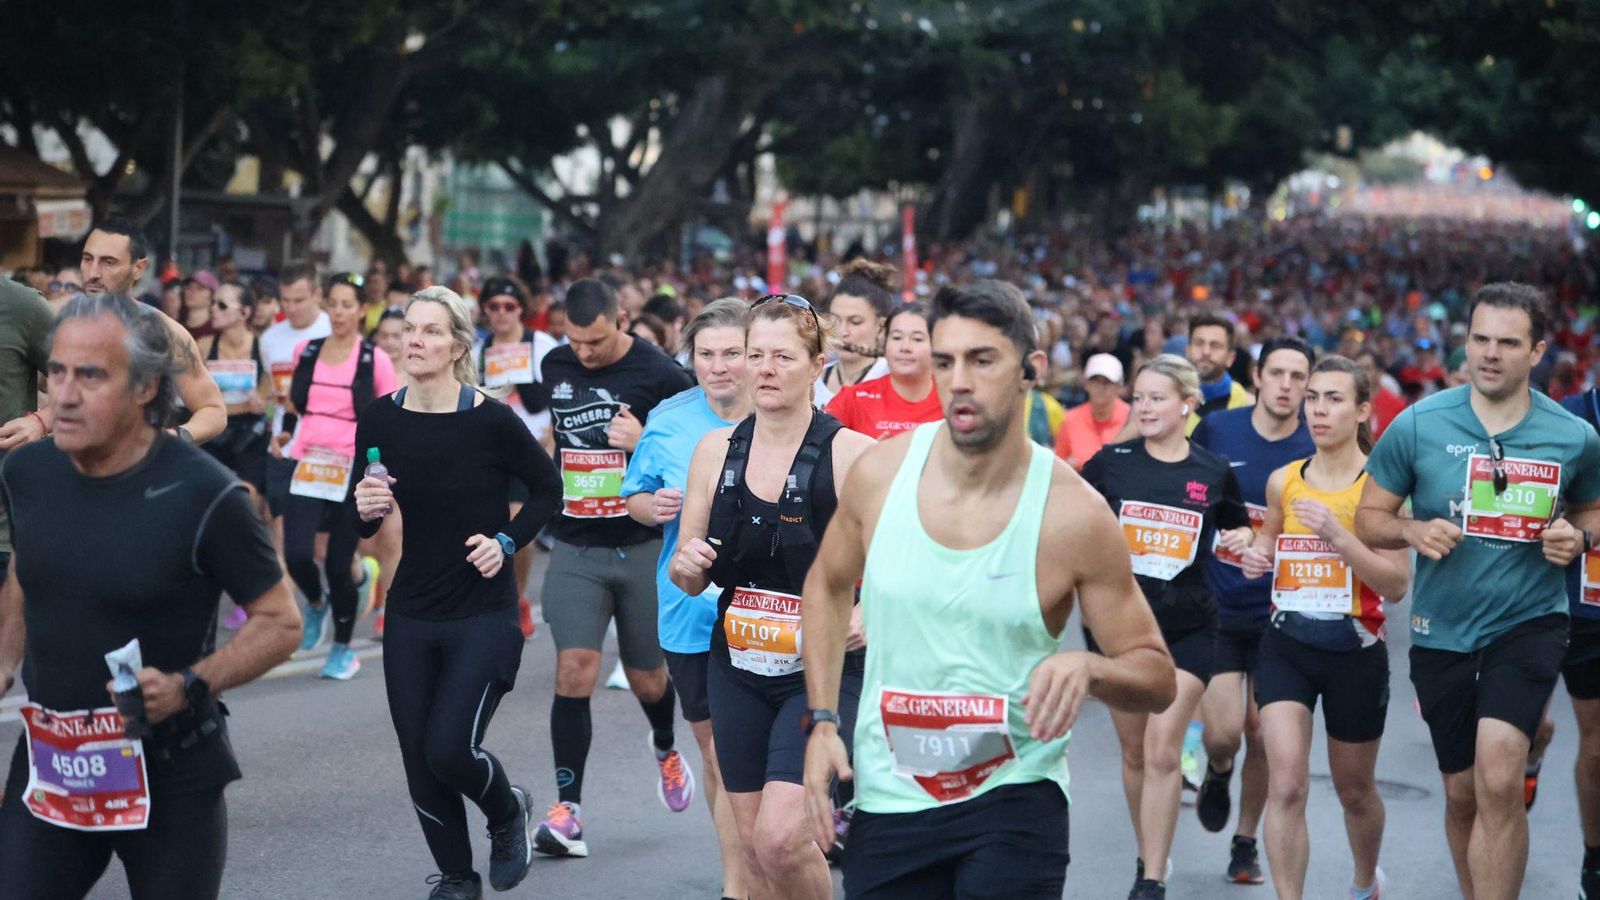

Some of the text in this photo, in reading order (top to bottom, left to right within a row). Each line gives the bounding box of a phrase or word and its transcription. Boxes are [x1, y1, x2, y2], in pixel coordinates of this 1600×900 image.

[563, 408, 612, 428] CHEERS
[573, 454, 620, 466] GENERALI
[1446, 444, 1476, 457] epm
[1501, 463, 1555, 480] ENERALI
[573, 475, 606, 489] 3657
[1494, 487, 1536, 505] 610
[1143, 508, 1196, 527] GENERALI
[1135, 528, 1181, 550] 16912
[1292, 540, 1337, 552] GENERA
[1289, 563, 1332, 578] 12181
[741, 594, 801, 615] GENERALI
[730, 619, 782, 643] 17107
[907, 698, 997, 718] GENERALI
[48, 714, 125, 736] ENERAL
[913, 734, 972, 757] 7911
[51, 752, 107, 779] 4508
